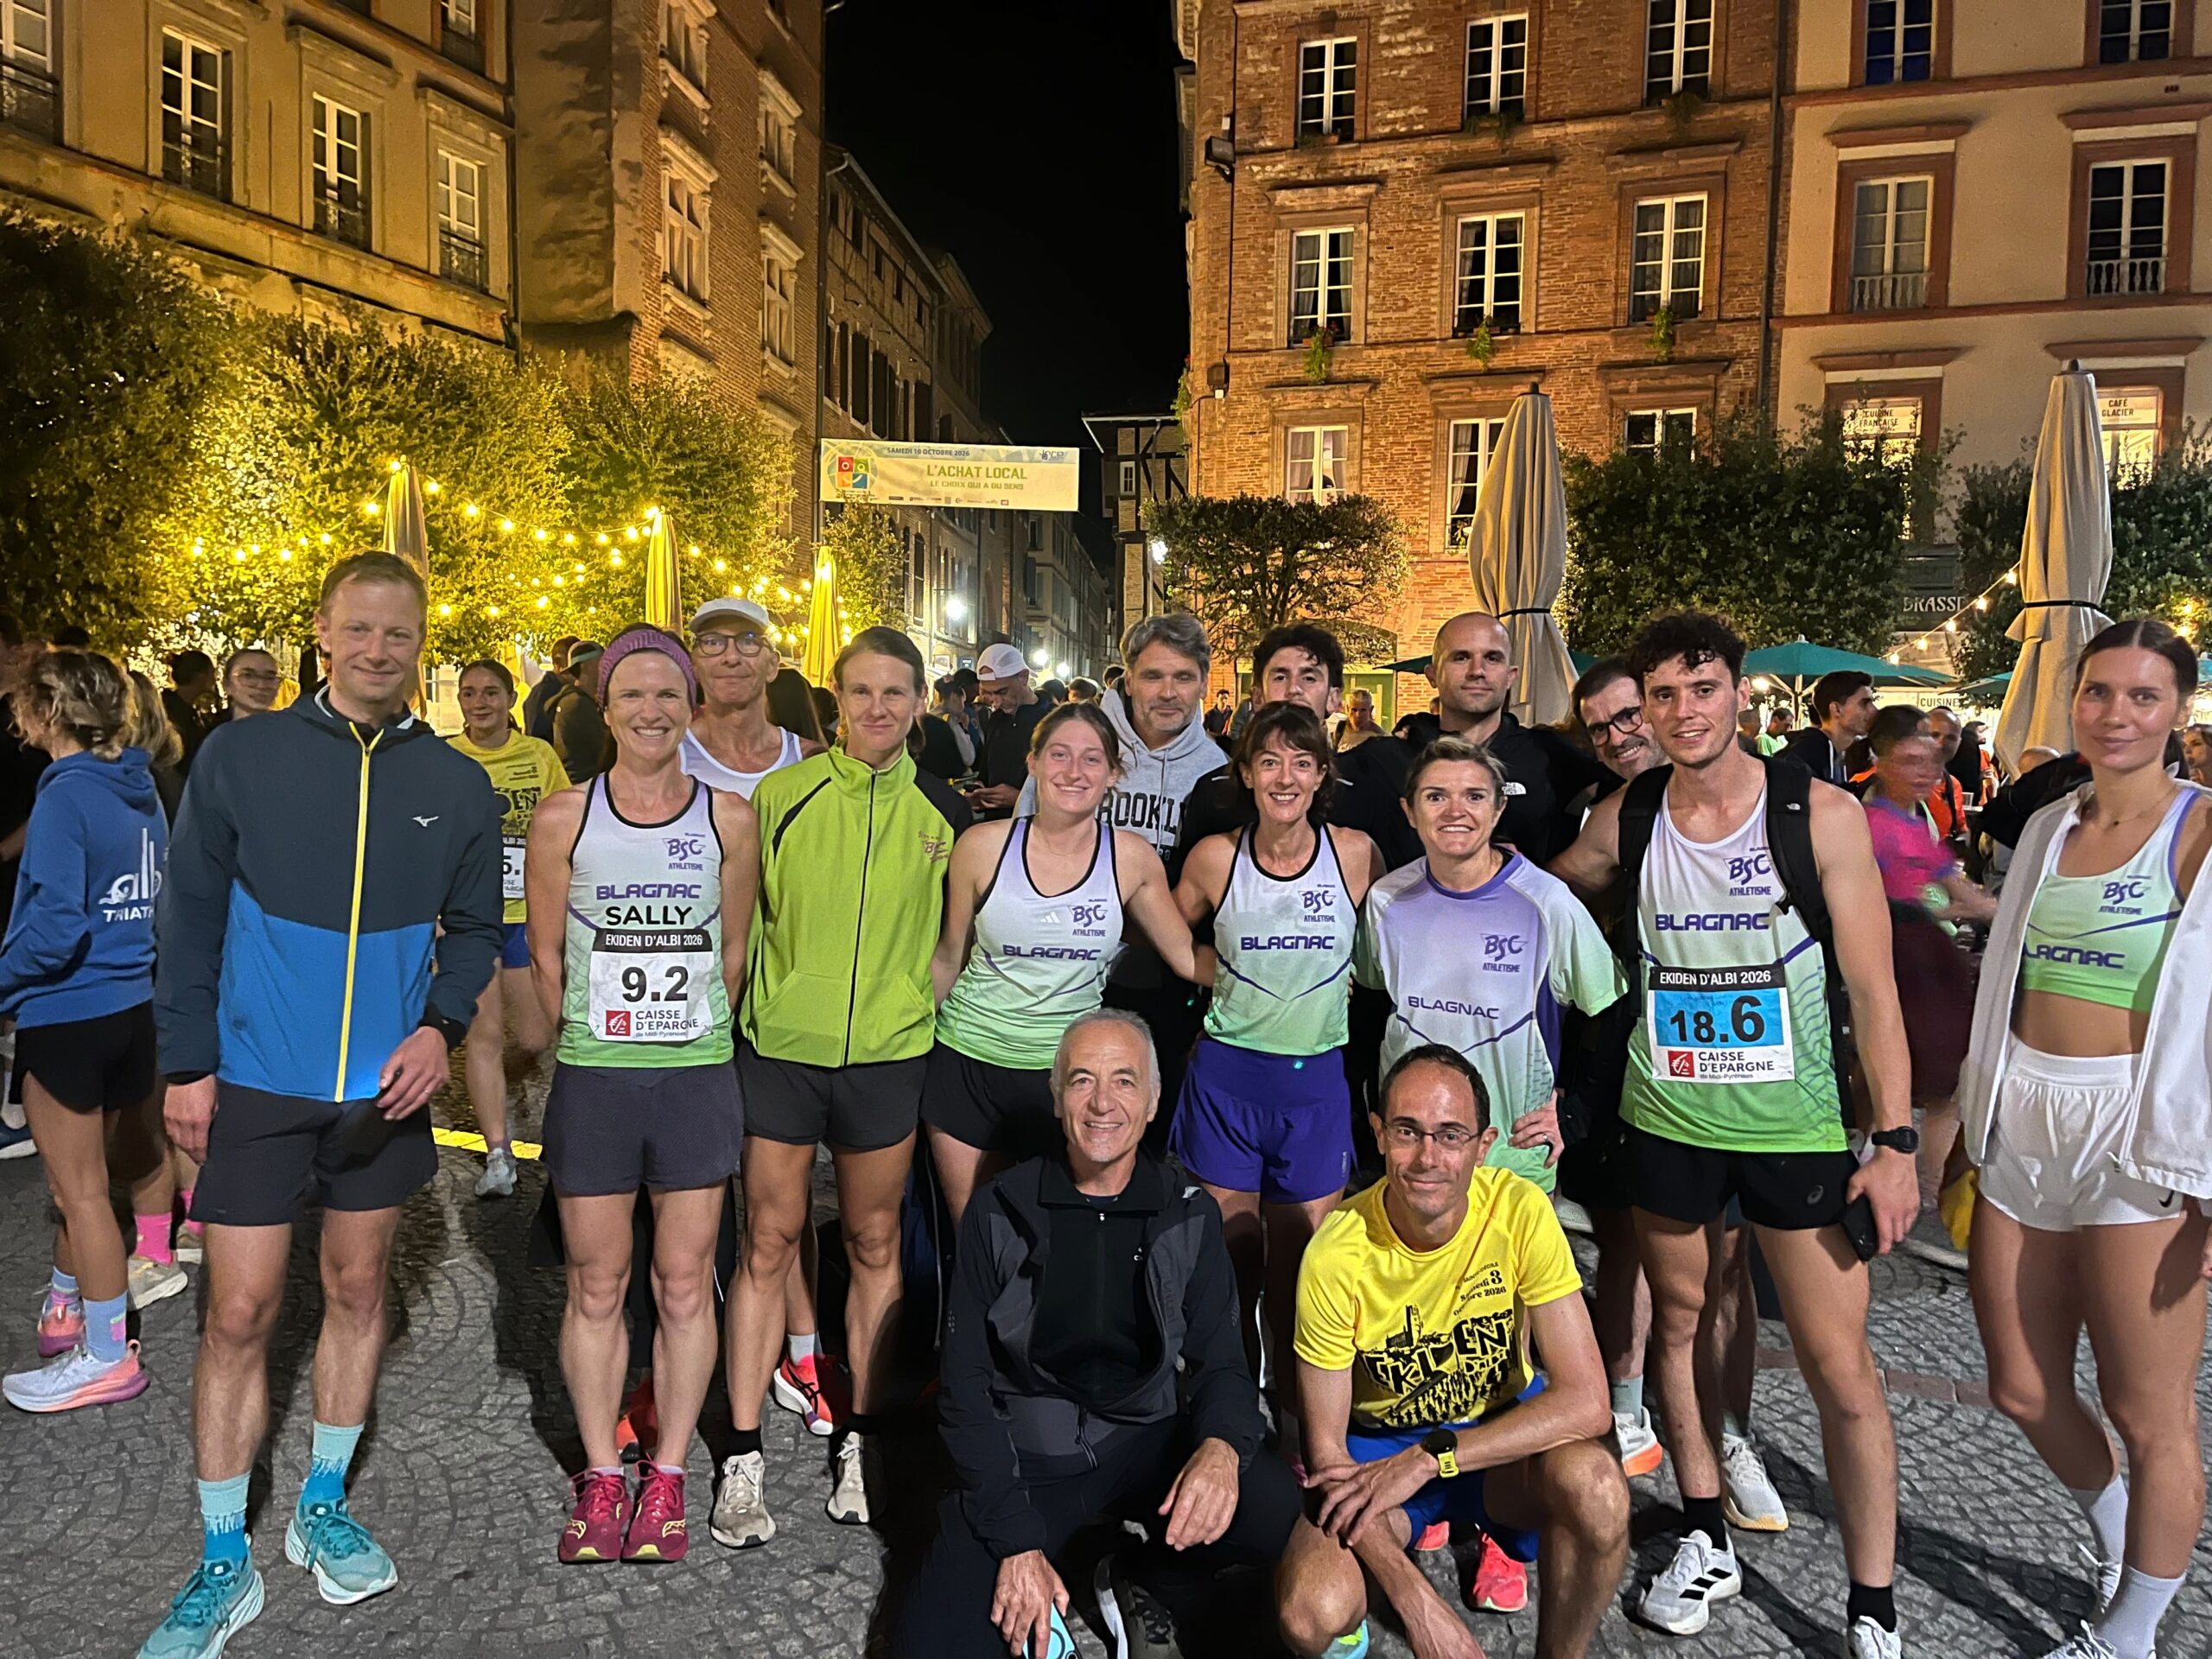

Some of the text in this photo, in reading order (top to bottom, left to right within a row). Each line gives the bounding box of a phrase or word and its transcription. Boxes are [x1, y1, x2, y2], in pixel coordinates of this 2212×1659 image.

[2108, 398, 2127, 407] CAFÉ
[927, 464, 1027, 480] L'ACHAT LOCAL
[1920, 697, 1957, 707] CUISINE
[667, 838, 702, 861] BSC
[669, 862, 703, 871] ATHLETISME
[1728, 854, 1771, 885] BSC
[596, 884, 702, 899] BLAGNAC
[1729, 887, 1771, 896] ATHLETISME
[2102, 881, 2145, 905] BSC
[1301, 890, 1333, 913] BSC
[606, 905, 692, 925] SALLY
[1071, 905, 1105, 927] BSC
[2098, 906, 2143, 915] ATHLETISME
[1656, 912, 1770, 931] BLAGNAC
[606, 934, 702, 947] EKIDEN D'ALBI 2026
[1241, 936, 1335, 950] BLAGNAC
[1002, 944, 1101, 960] BLAGNAC
[1484, 935, 1522, 962] BSC
[2023, 942, 2125, 969] LAGNAC
[1483, 963, 1521, 972] ATHLETISME
[621, 965, 689, 1002] 9.2
[1660, 970, 1771, 985] EKIDEN D'ALBI 2026
[636, 1010, 681, 1020] CAISSE
[1408, 995, 1499, 1020] BLAGNAC
[636, 1019, 699, 1031] D'EPARGNE
[1670, 995, 1765, 1043] 18.6
[1698, 1052, 1745, 1062] CAISSE
[1700, 1061, 1775, 1072] D'EPARGNE
[1490, 1269, 1502, 1284] 3
[1484, 1286, 1507, 1297] 2026
